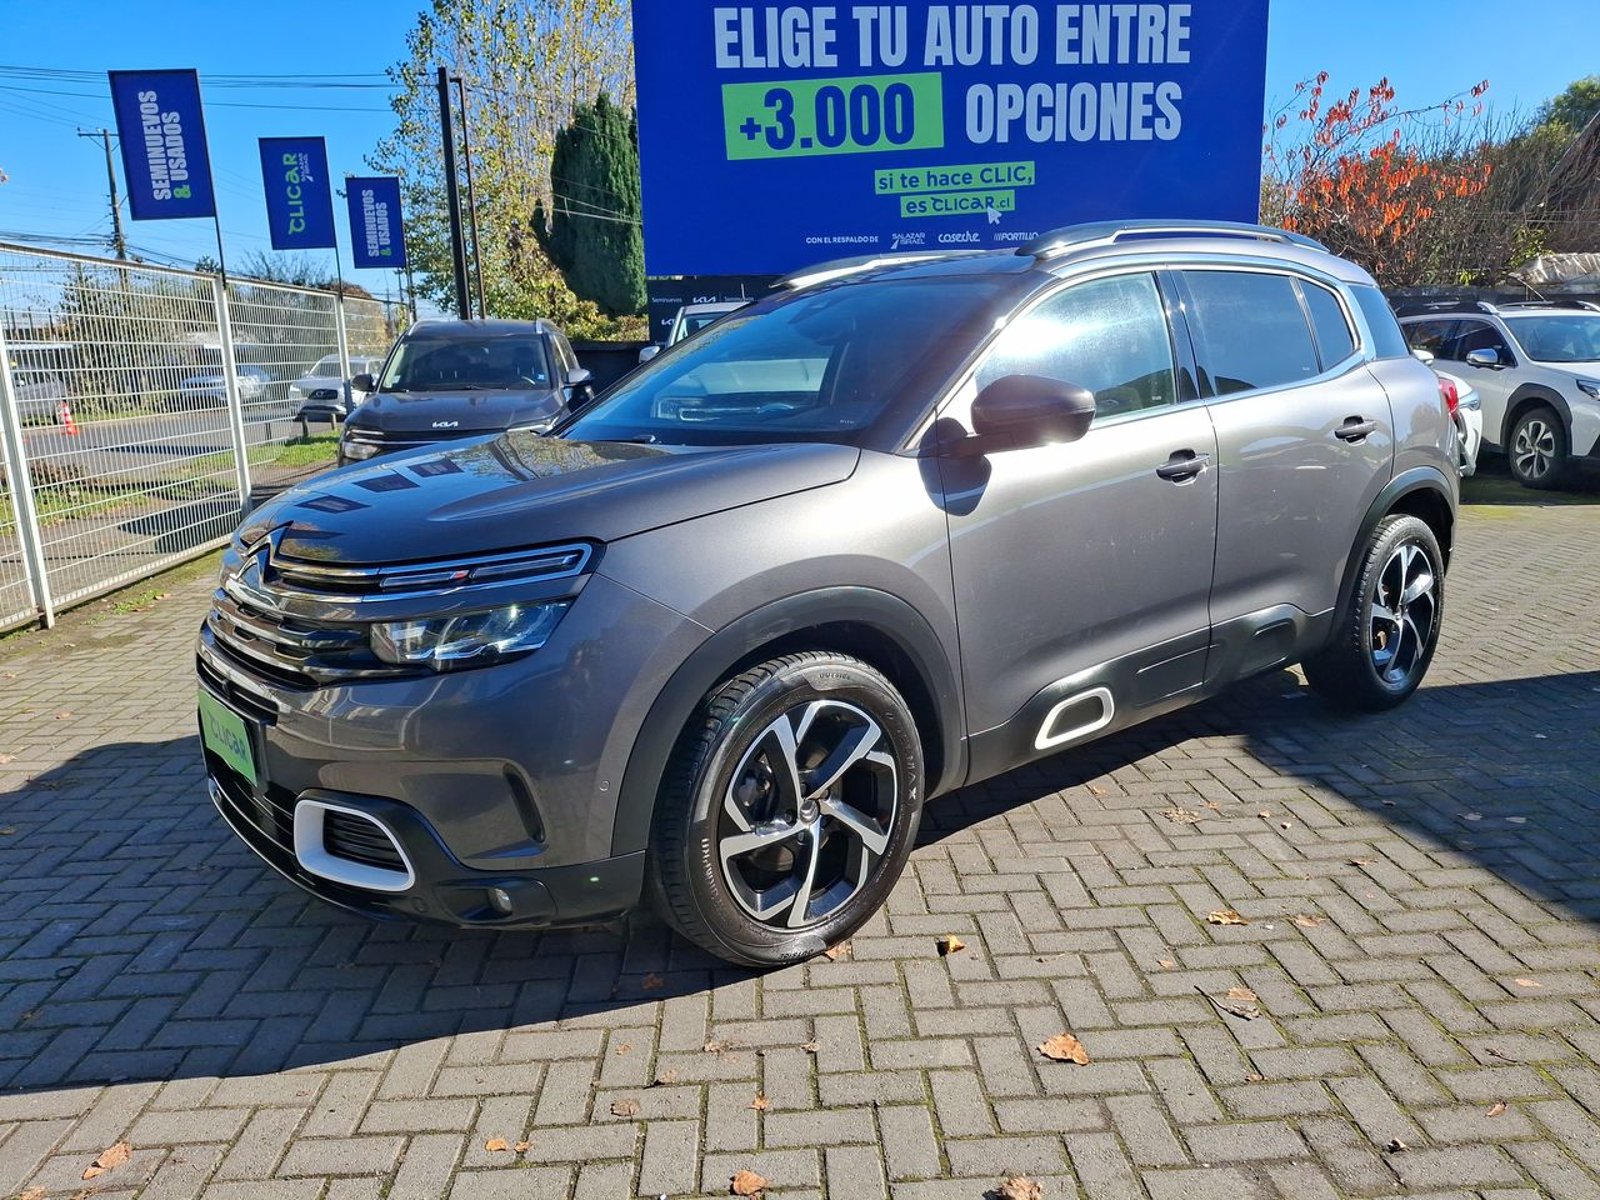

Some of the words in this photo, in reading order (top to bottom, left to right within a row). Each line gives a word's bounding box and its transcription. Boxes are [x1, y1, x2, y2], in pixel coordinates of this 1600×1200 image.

[713, 6, 838, 69] ELIGE
[852, 5, 908, 67] TU
[923, 4, 1039, 66] AUTO
[1055, 4, 1191, 65] ENTRE
[739, 82, 915, 151] +3.000
[965, 81, 1182, 144] OPCIONES
[138, 90, 172, 200] SEMINUEVOS
[161, 111, 189, 181] USADOS
[173, 184, 192, 199] &
[879, 173, 894, 190] si
[900, 173, 919, 188] te
[927, 171, 973, 187] hace
[979, 165, 1033, 184] CLIC,
[362, 189, 380, 257] SEMINUEVOS
[375, 202, 391, 246] USADOS
[905, 201, 928, 214] es
[805, 236, 823, 245] CON
[824, 236, 832, 244] EL
[832, 235, 869, 244] RESPALDO
[869, 235, 879, 243] DE
[892, 232, 926, 240] SALAZAR
[938, 230, 981, 244] coseche
